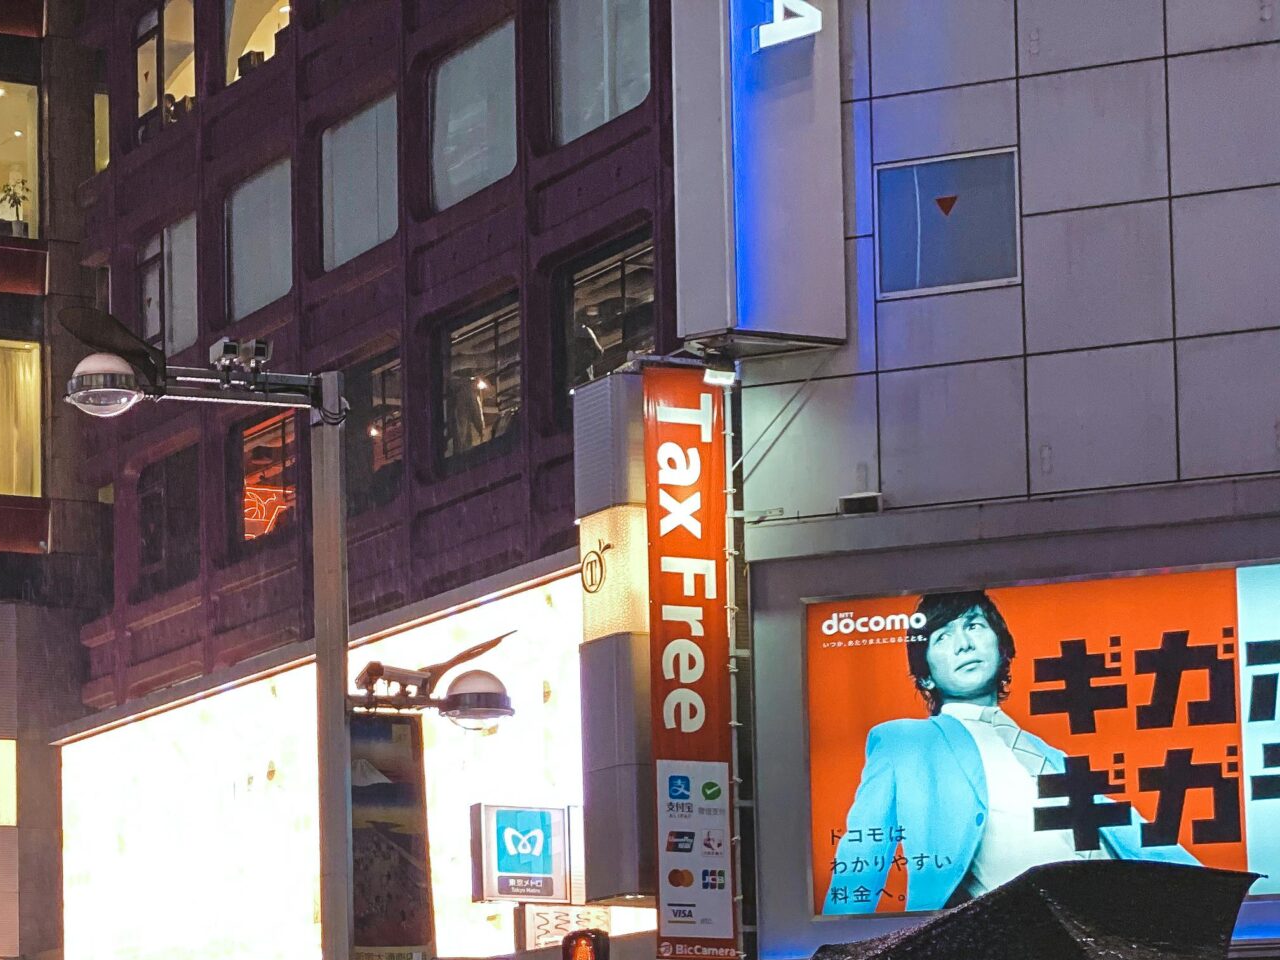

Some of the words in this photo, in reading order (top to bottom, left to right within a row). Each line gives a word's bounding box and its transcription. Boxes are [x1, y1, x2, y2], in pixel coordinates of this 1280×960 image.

[656, 393, 713, 541] Tax
[821, 612, 927, 636] docomo
[660, 556, 718, 734] Free
[1029, 626, 1237, 736] ギガ
[1033, 744, 1243, 852] ギガ
[830, 824, 907, 846] ドコモは
[830, 853, 953, 876] わかりやすい
[830, 885, 907, 905] 料金へ。
[672, 909, 694, 918] VISA
[676, 944, 736, 957] BicCamera
